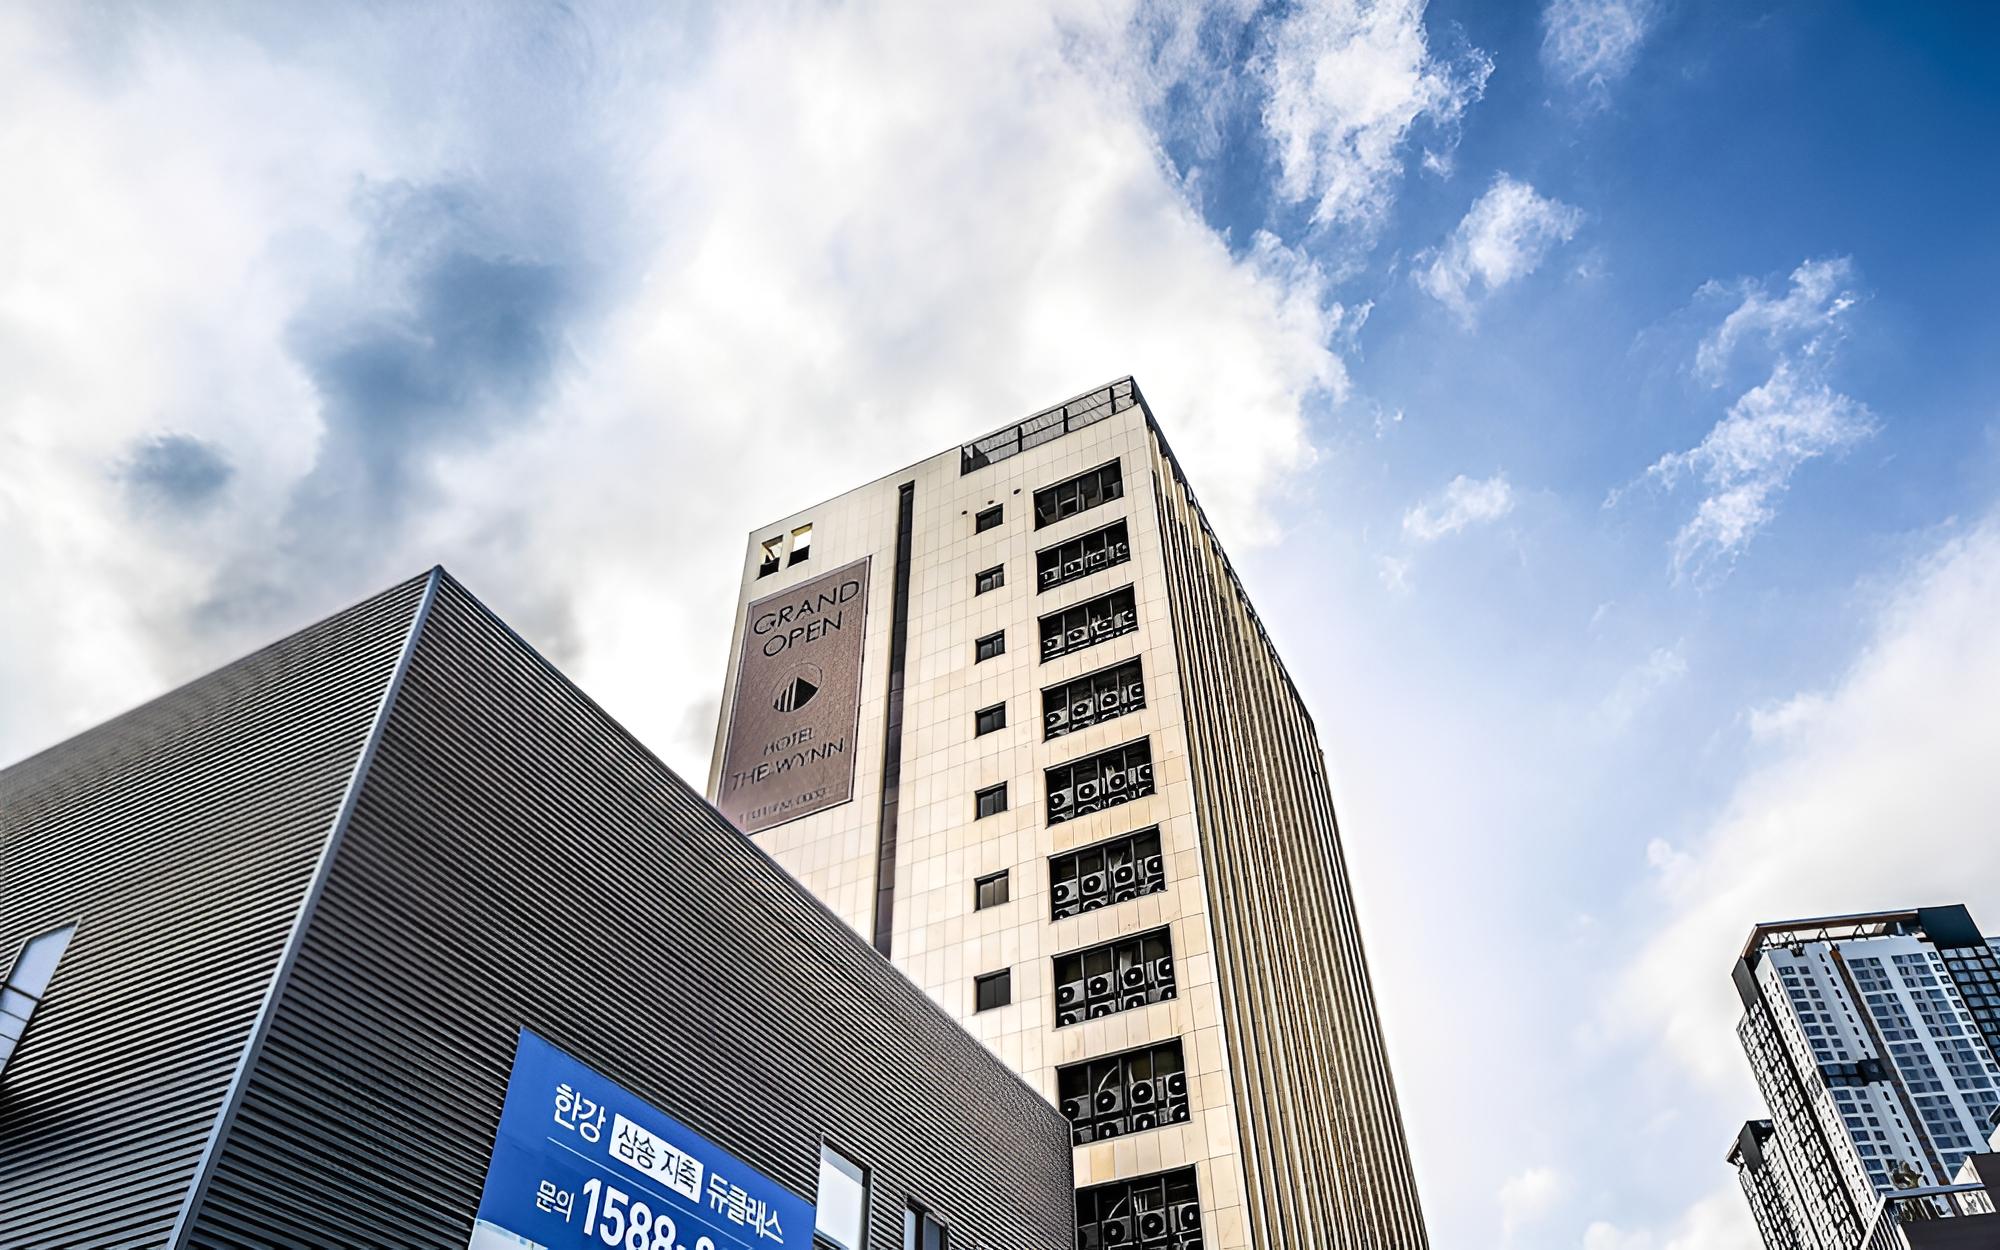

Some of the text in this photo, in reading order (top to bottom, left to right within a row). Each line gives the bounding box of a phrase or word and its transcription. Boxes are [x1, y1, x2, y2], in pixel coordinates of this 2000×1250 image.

[753, 580, 860, 635] GRAND
[763, 611, 843, 657] OPEN
[732, 737, 844, 790] THE WYNN
[763, 728, 815, 756] HOTEL
[554, 1083, 784, 1244] 한강 삼송 지축 듀클래스
[536, 1178, 715, 1250] 문의 1588-
